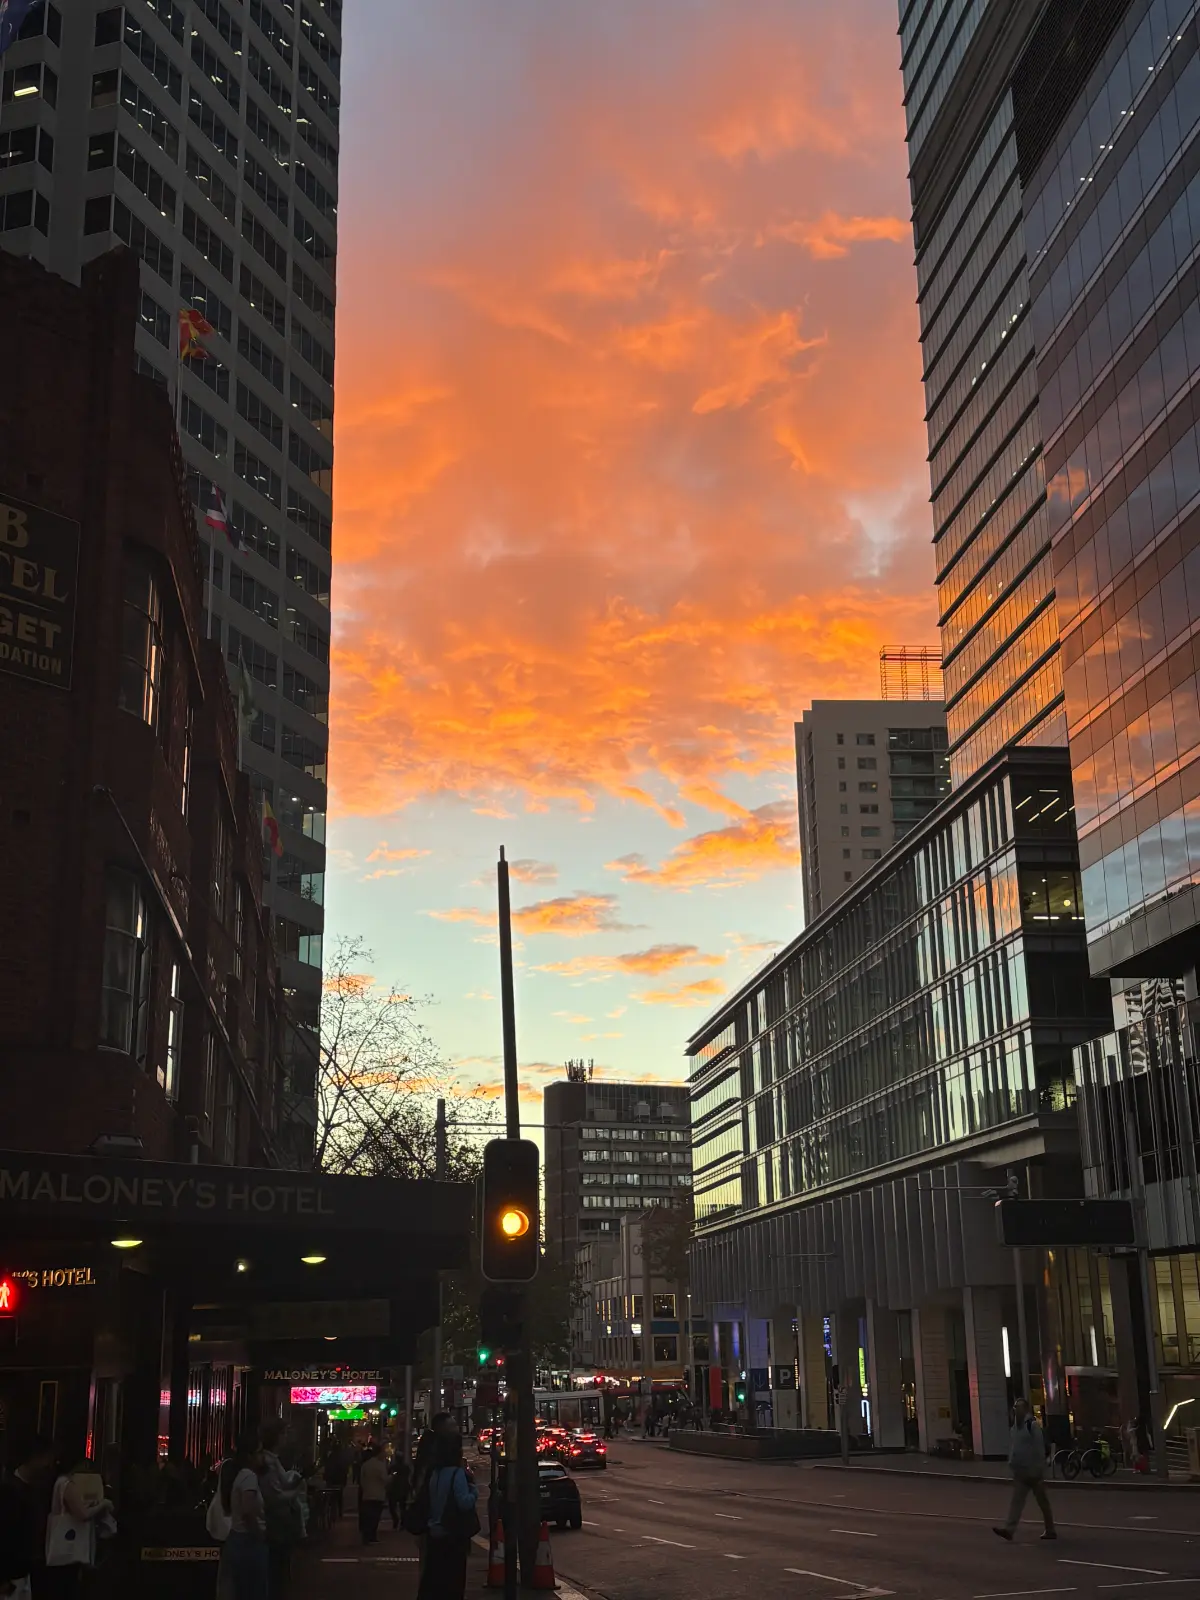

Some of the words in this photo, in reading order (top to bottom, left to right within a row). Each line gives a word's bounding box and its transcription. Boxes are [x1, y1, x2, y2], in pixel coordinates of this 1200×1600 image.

[0, 1169, 216, 1209] MALONEY'S
[226, 1182, 335, 1215] HOTEL
[41, 1267, 96, 1287] HOTEL
[264, 1370, 338, 1380] MALONEY'S
[341, 1370, 383, 1380] HOTEL
